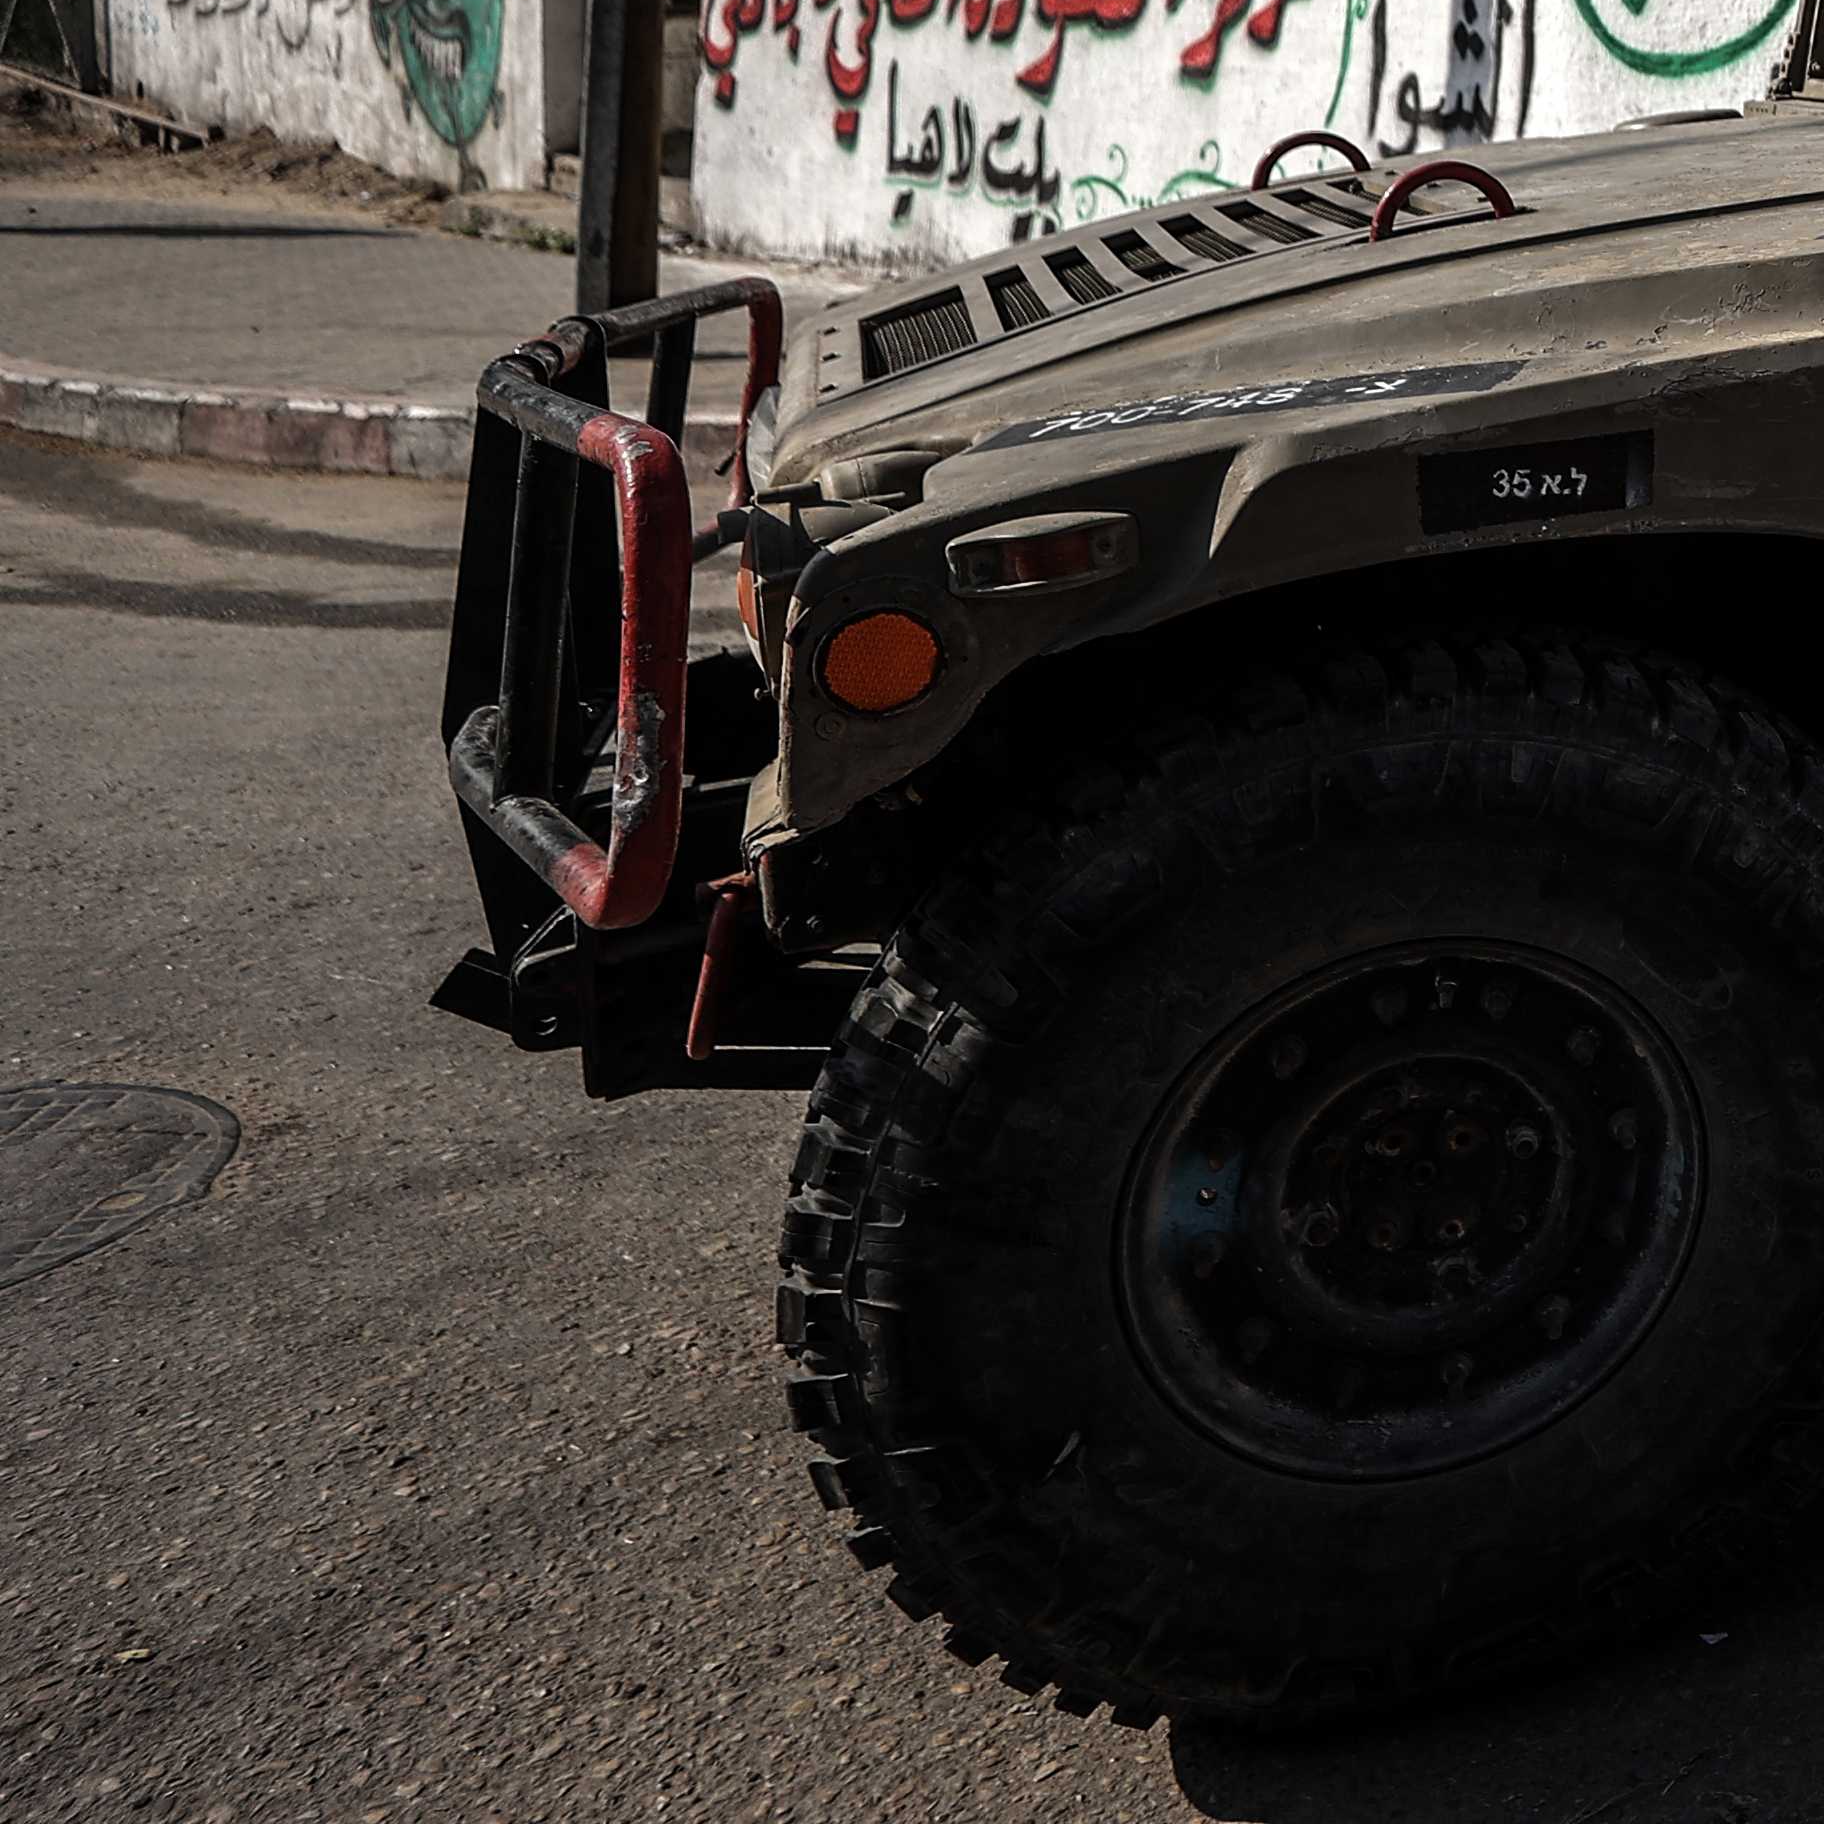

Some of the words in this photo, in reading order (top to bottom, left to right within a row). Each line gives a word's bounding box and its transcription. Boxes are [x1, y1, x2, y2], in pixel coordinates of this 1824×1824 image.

[886, 58, 976, 222] لاهيا
[981, 116, 1062, 244] بيت
[1492, 468, 1533, 499] 35
